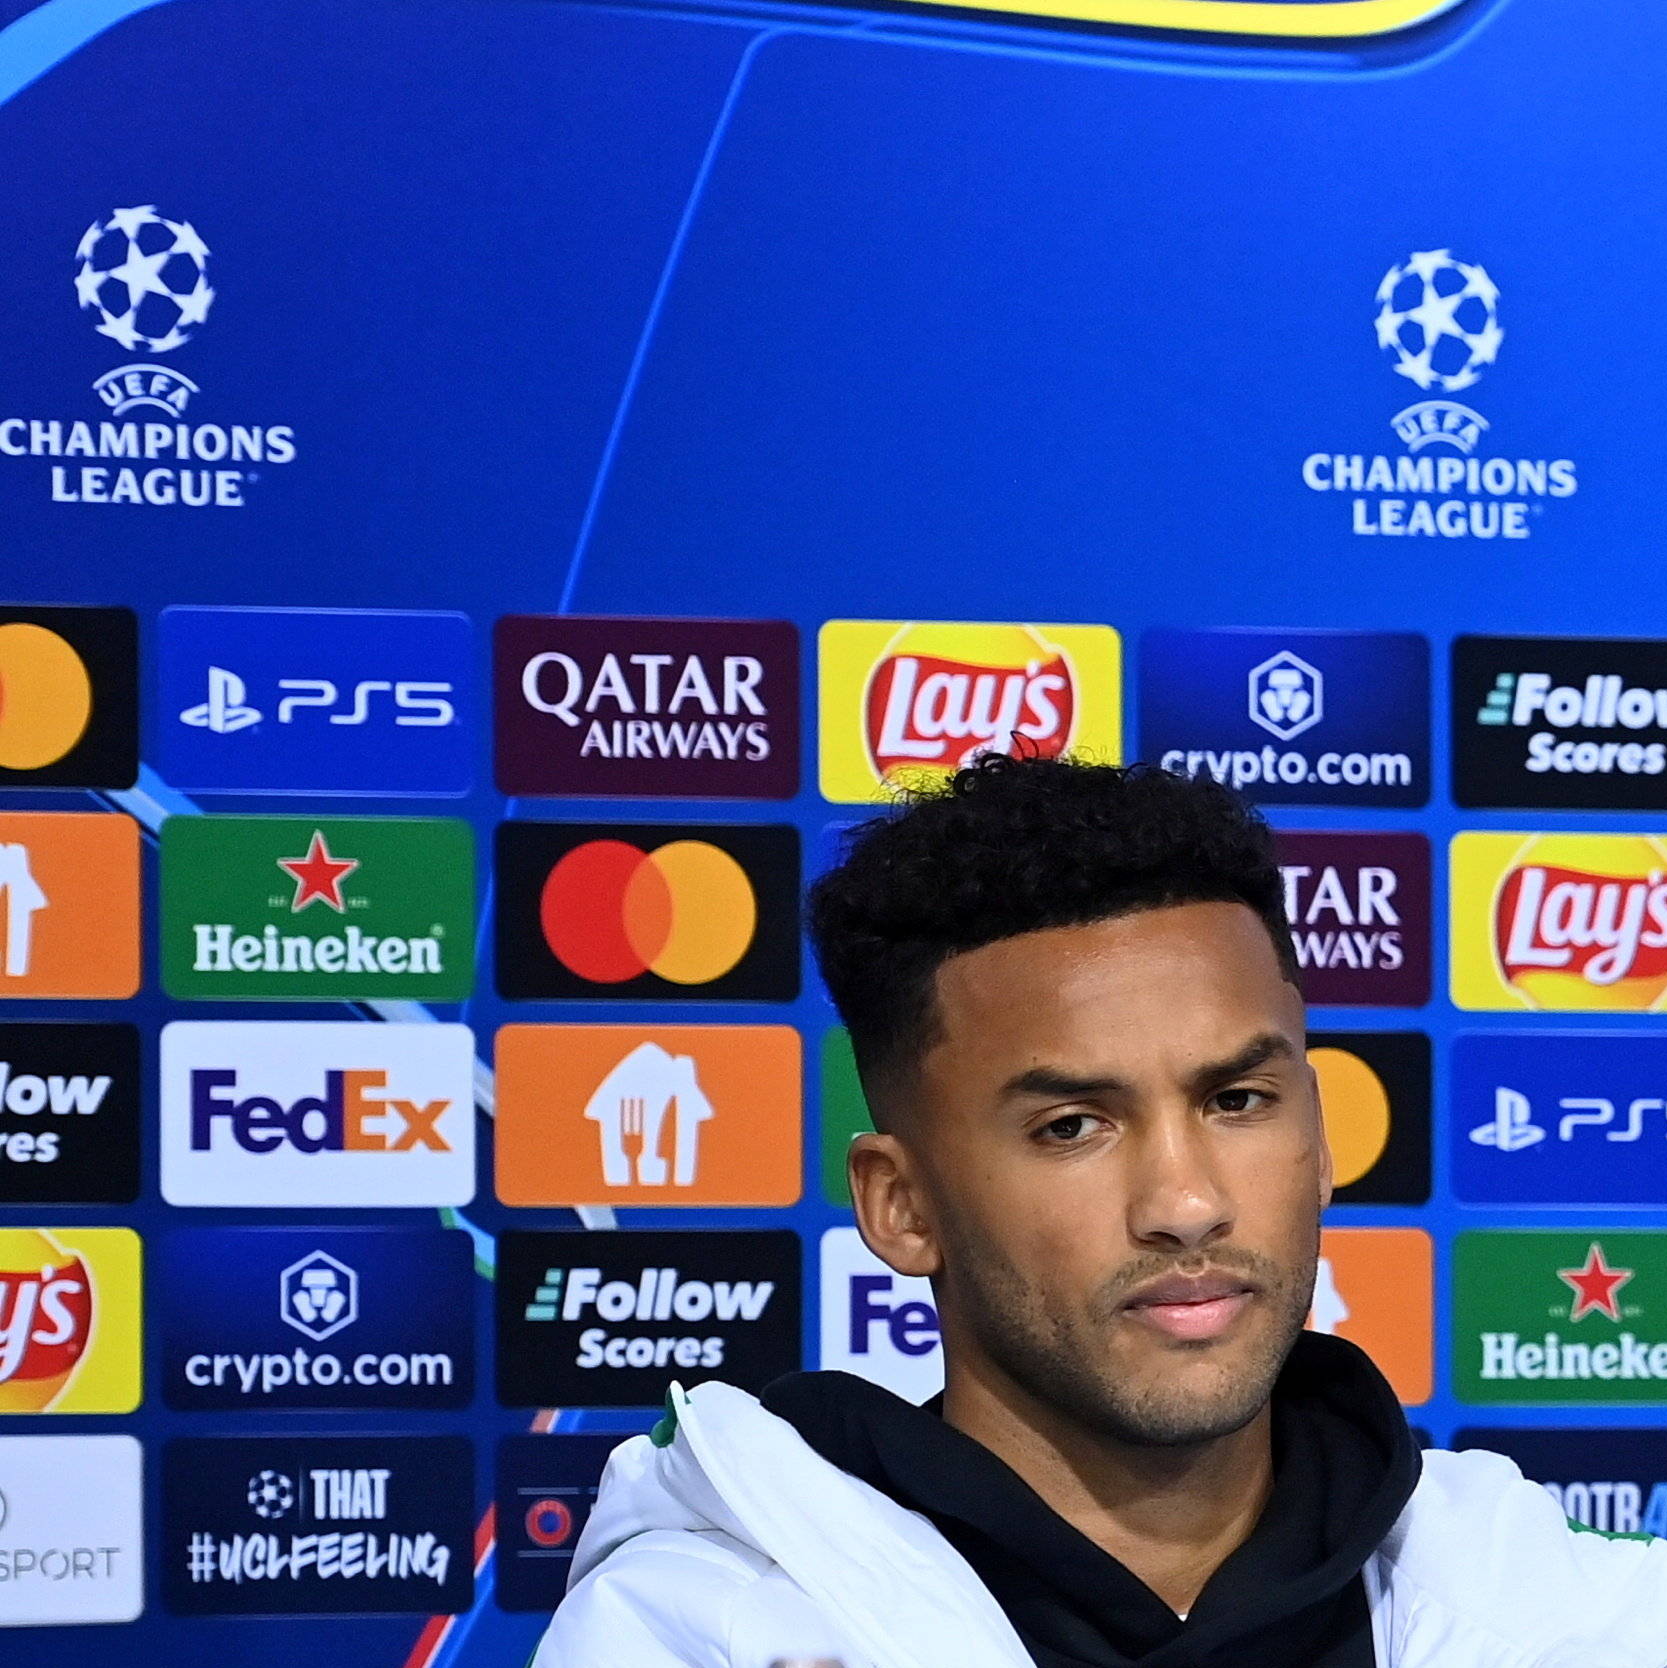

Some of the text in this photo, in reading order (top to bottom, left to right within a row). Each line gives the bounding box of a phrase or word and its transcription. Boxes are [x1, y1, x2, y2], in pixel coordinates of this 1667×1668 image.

[98, 372, 190, 410] UEFA
[0, 419, 295, 463] CHAMPIONS
[1394, 411, 1484, 446] UEFA
[52, 466, 243, 506] LEAGUE
[1303, 453, 1577, 497] CHAMPIONS
[1353, 499, 1530, 538] LEAGUE
[279, 680, 454, 726] PS5
[522, 652, 765, 726] QATAR
[877, 657, 1066, 772] Lay's
[581, 720, 769, 761] AIRWAYS
[1525, 733, 1666, 774] Scores
[1160, 744, 1411, 790] crypto.com
[1277, 866, 1401, 925] TAR
[193, 925, 442, 973] Heineken
[1290, 931, 1404, 970] WAYS
[190, 1069, 453, 1154] FedEx
[563, 1269, 774, 1321] Follow
[185, 1348, 452, 1393] crypto.com
[576, 1329, 723, 1368] Scores
[310, 1469, 390, 1519] THAT
